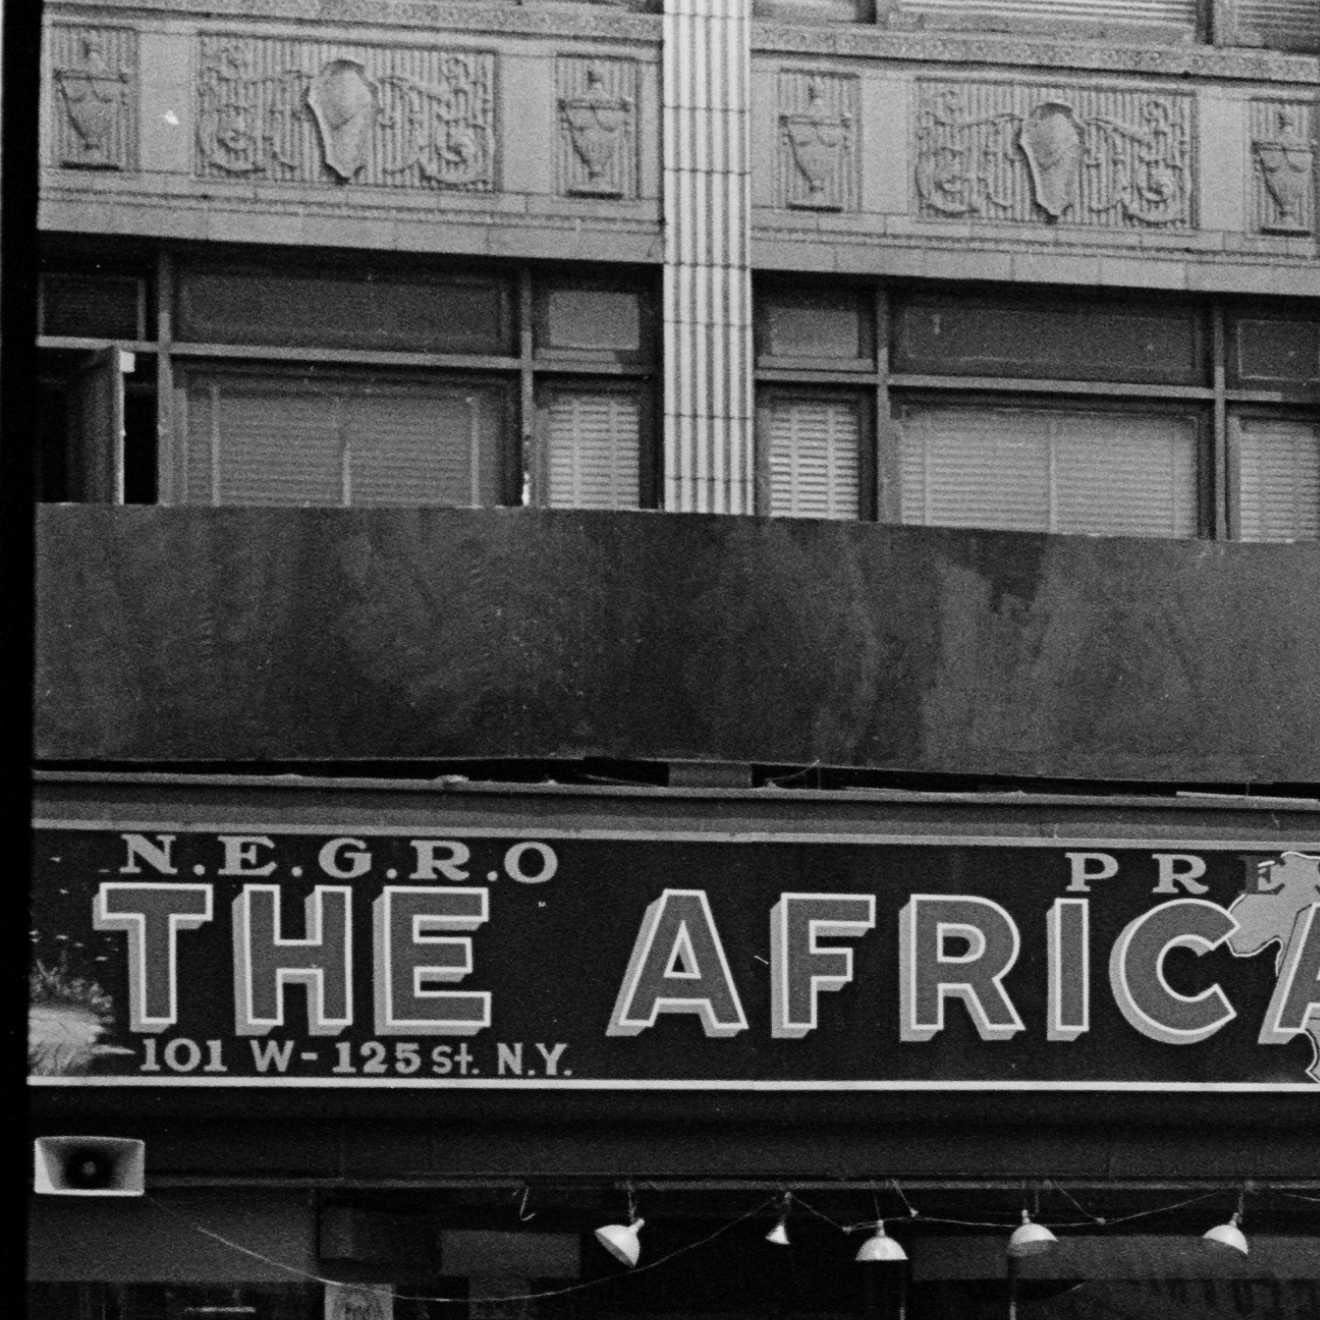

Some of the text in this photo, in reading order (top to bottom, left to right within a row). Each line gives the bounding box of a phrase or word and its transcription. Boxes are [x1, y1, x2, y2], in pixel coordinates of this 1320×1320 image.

[93, 882, 492, 1036] THE
[139, 1038, 228, 1072] 101
[497, 1043, 573, 1077] N.Y.
